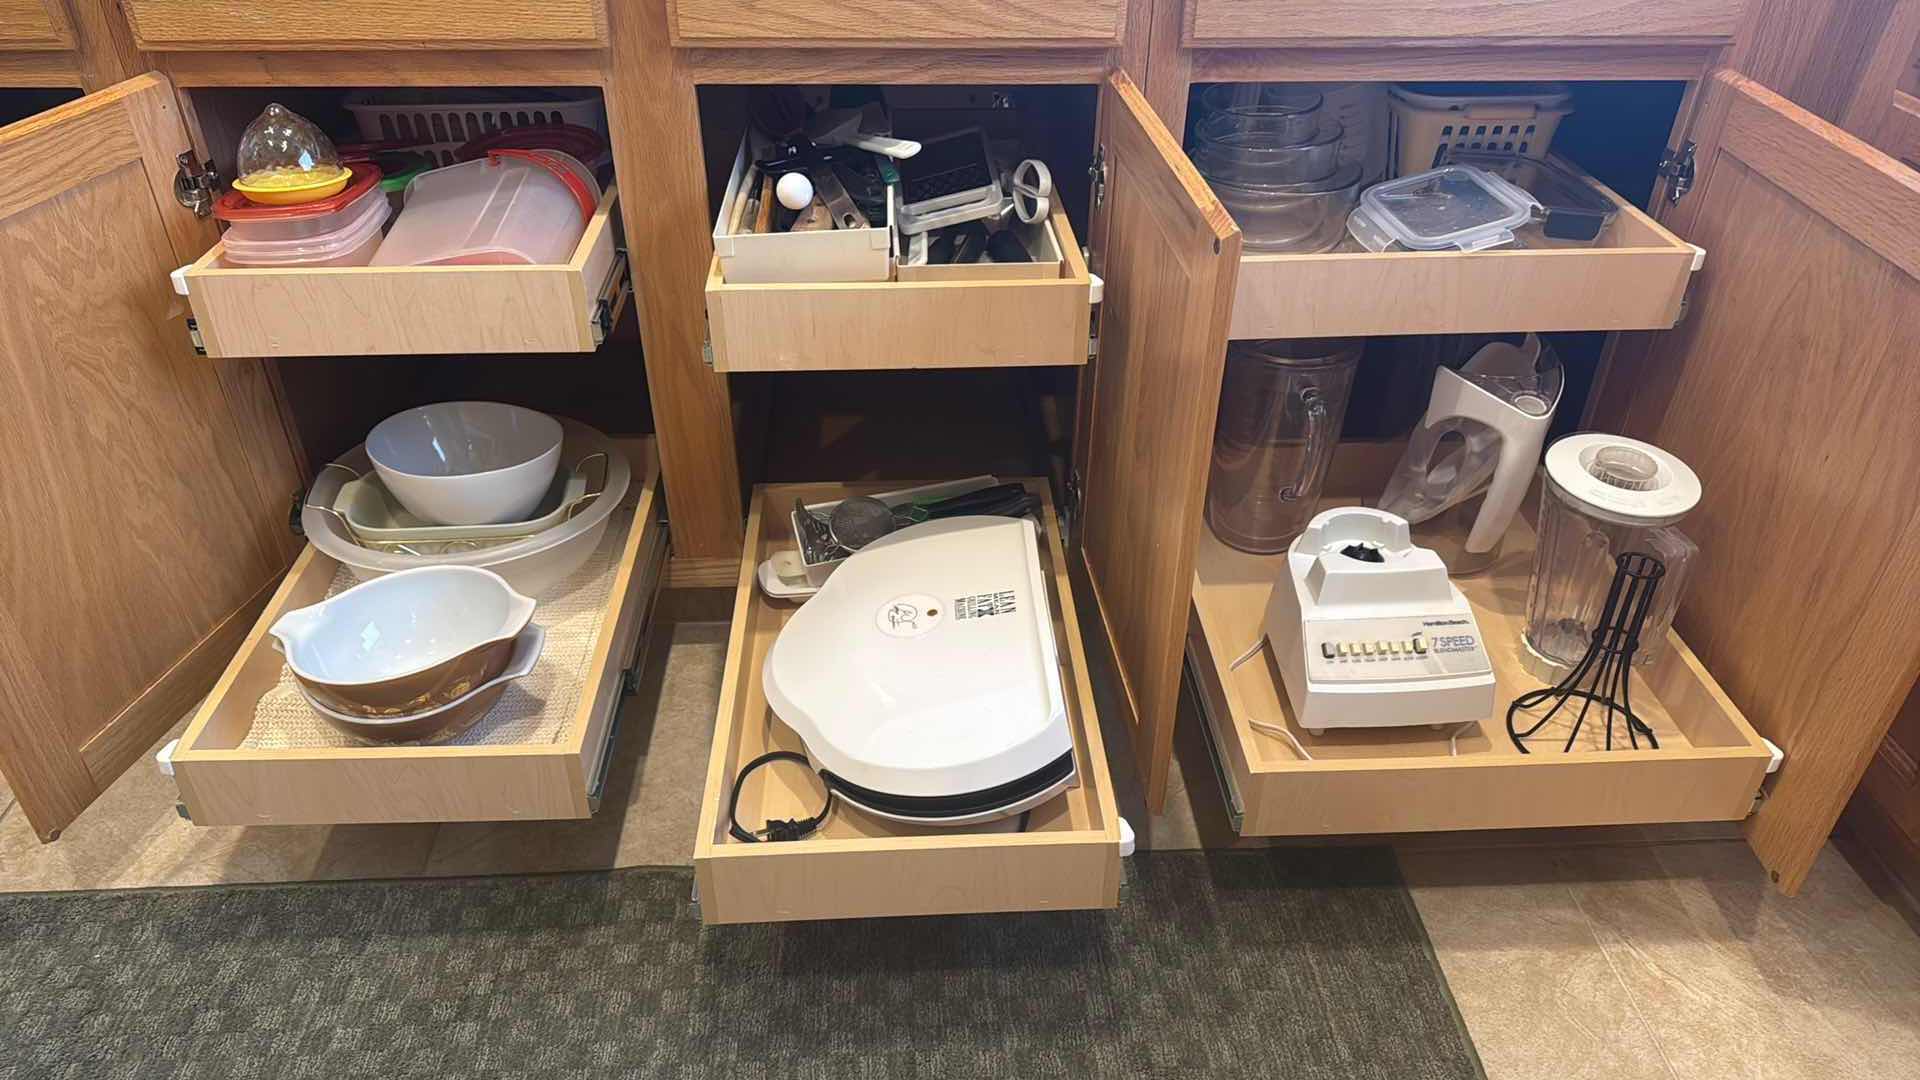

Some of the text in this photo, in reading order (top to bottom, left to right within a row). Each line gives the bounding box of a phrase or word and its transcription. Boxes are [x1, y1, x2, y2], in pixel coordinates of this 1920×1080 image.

[954, 598, 967, 620] MACHINE
[999, 590, 1016, 614] LEAN
[1431, 635, 1475, 648] 7 SPEED
